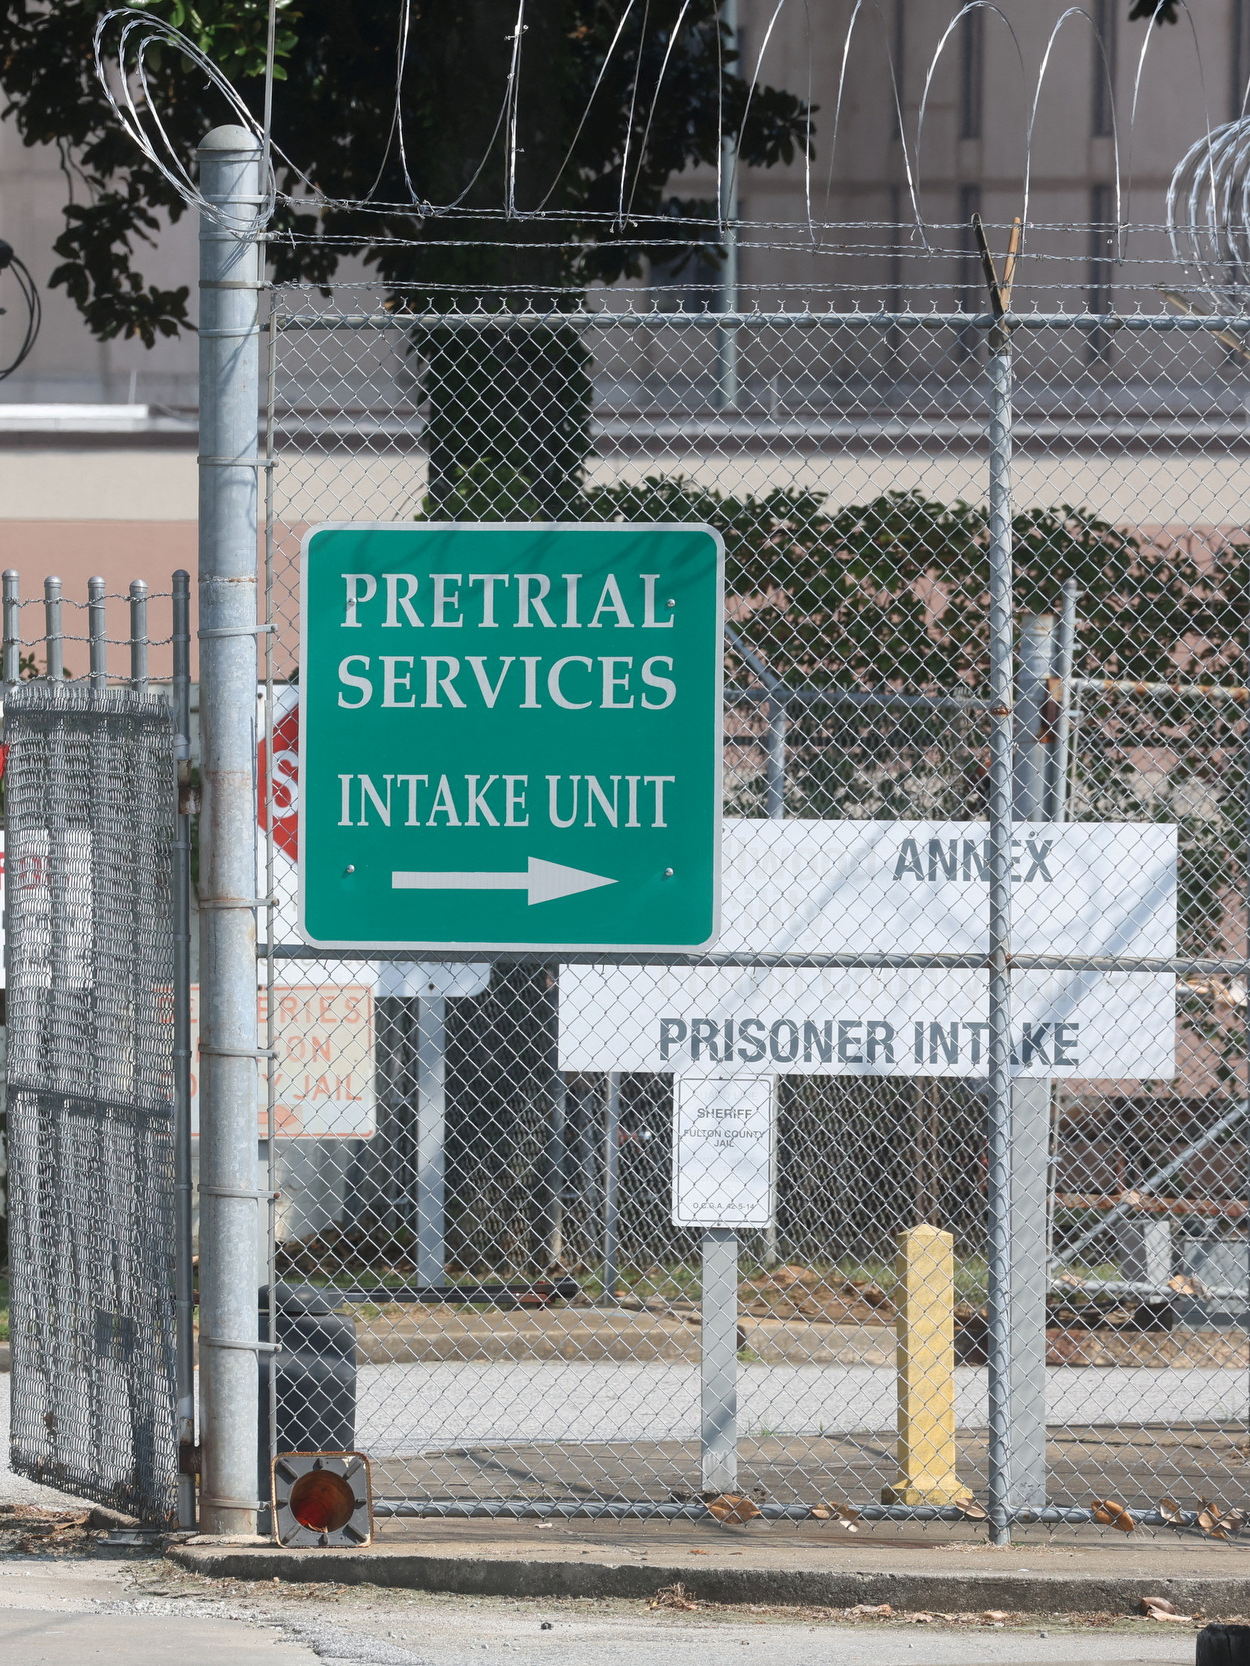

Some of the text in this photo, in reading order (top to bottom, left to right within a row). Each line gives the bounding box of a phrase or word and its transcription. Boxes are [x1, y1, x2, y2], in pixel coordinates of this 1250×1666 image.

[340, 573, 675, 629] PRETRIAL
[337, 655, 676, 710] SERVICES
[338, 773, 530, 827] INTAKE
[545, 774, 676, 828] UNIT
[659, 1018, 1080, 1066] PRISONER INTKE
[293, 1074, 363, 1101] JAIL
[697, 1108, 753, 1119] SHERIFF
[683, 1129, 765, 1139] FULTON COUNTY
[714, 1140, 735, 1148] JAIL
